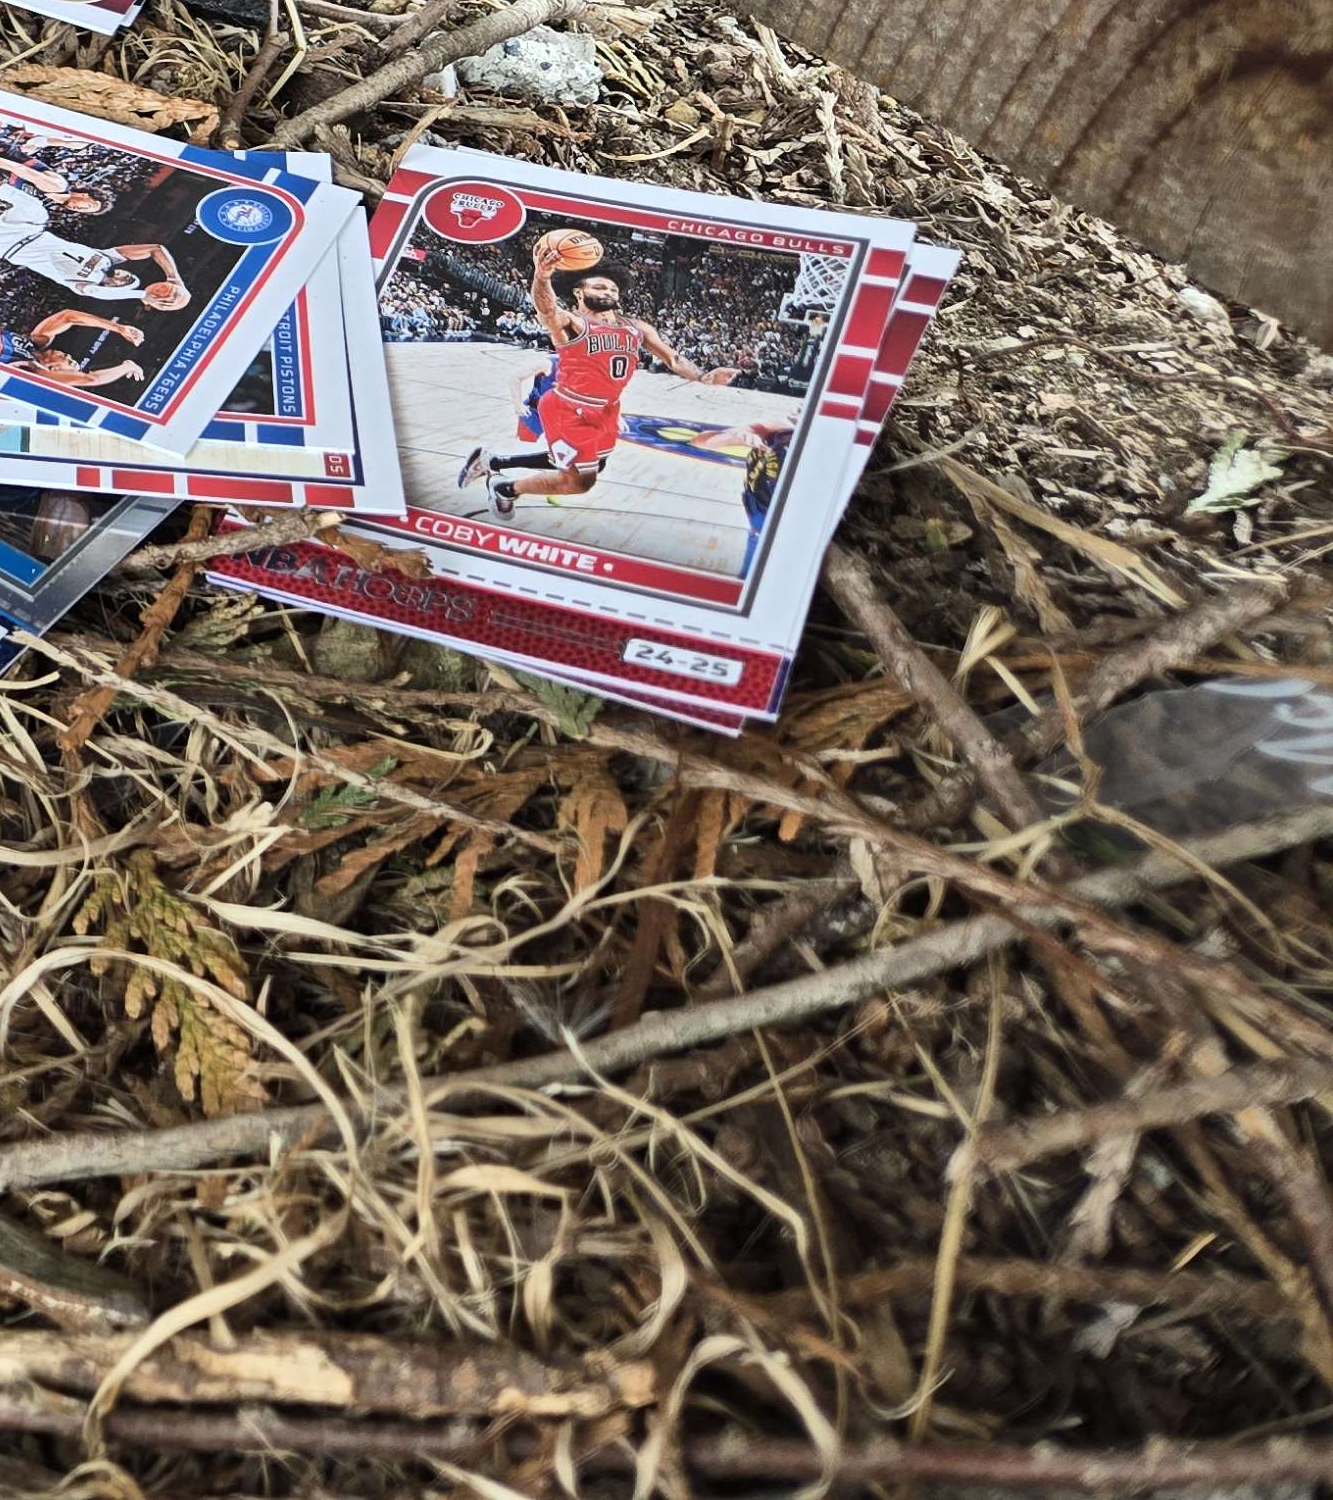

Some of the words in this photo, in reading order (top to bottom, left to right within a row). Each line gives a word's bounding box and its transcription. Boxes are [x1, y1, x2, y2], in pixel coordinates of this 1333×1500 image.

[452, 192, 505, 208] CHICAGO
[458, 199, 492, 211] BULLS
[61, 245, 85, 266] 7
[666, 218, 764, 244] CHICAGO
[771, 234, 846, 256] BULLS
[171, 282, 241, 373] PHILADELPHIA
[279, 355, 296, 413] PISTONS
[609, 354, 629, 380] 0
[142, 368, 181, 413] 76ERS
[412, 513, 495, 549] COBY
[495, 533, 599, 573] WHITE
[230, 538, 329, 586] NBA
[323, 562, 478, 624] HOOPS
[633, 642, 730, 679] 24-25
